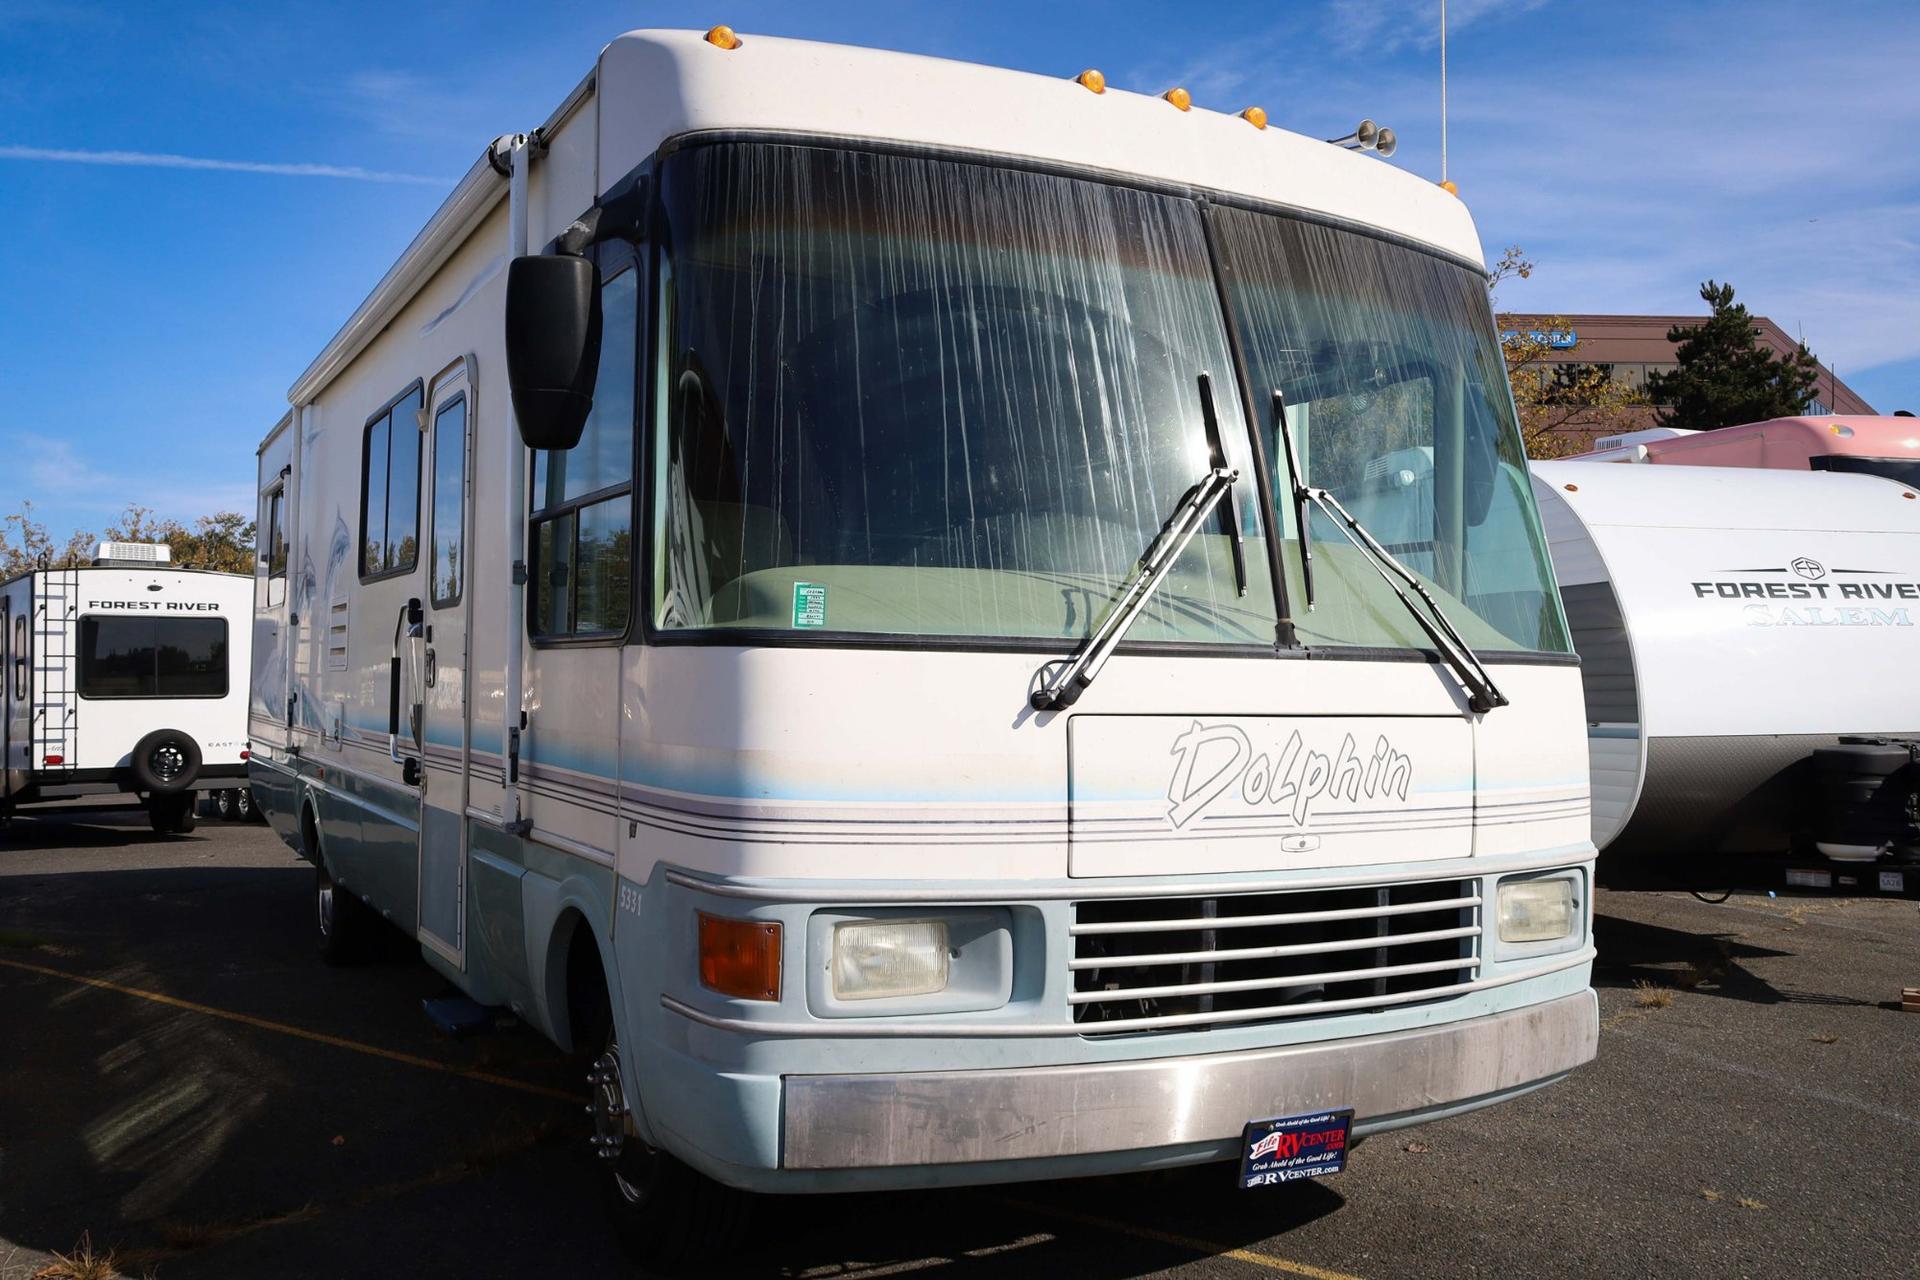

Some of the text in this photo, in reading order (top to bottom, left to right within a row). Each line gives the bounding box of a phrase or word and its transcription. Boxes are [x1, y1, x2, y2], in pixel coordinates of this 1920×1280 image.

[1691, 582, 1920, 600] FOREST RIVE
[88, 600, 220, 611] FOREST RIVER
[1743, 603, 1914, 627] SALEM
[1167, 719, 1413, 829] Dolphin
[1257, 1134, 1276, 1151] Fife
[1252, 1162, 1268, 1171] Grab
[1269, 1159, 1288, 1169] Ahold
[1288, 1158, 1295, 1168] of
[1295, 1157, 1305, 1165] the
[1306, 1153, 1322, 1163] Good
